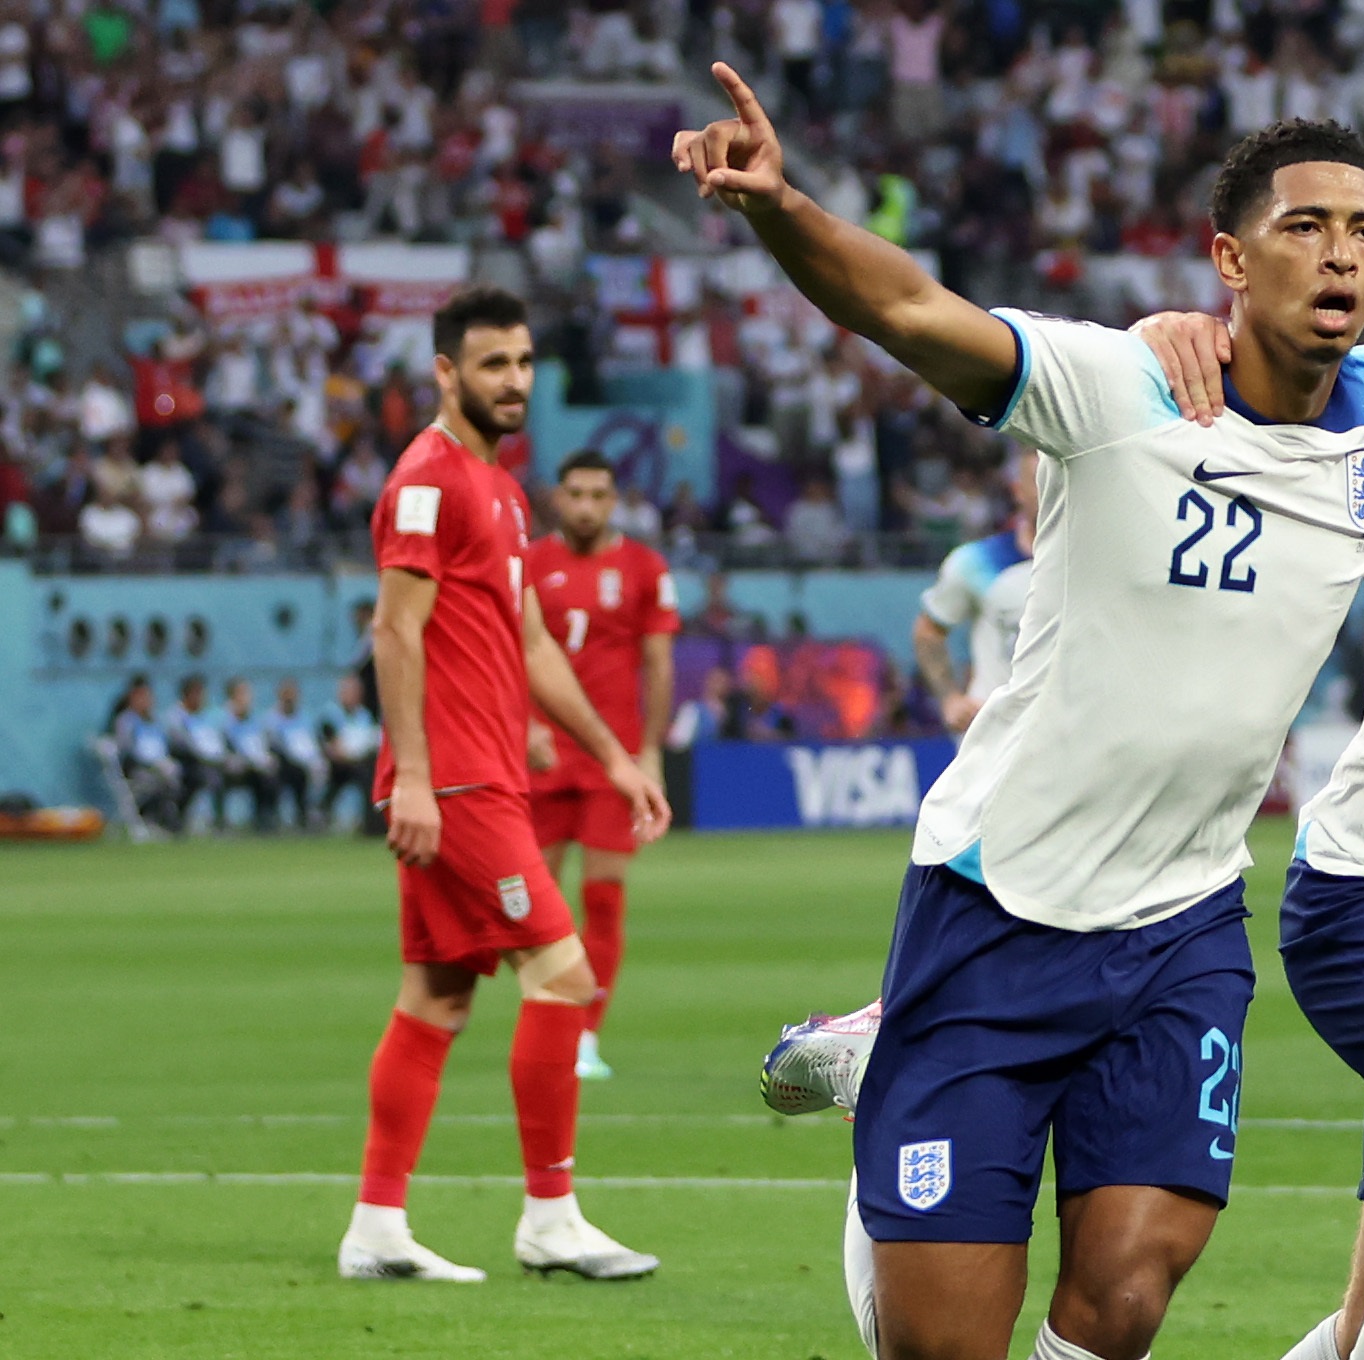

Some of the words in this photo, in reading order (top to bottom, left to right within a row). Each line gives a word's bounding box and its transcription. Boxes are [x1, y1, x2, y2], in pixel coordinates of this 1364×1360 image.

[1168, 488, 1263, 593] 22
[564, 607, 589, 653] 1
[786, 746, 920, 824] VISA
